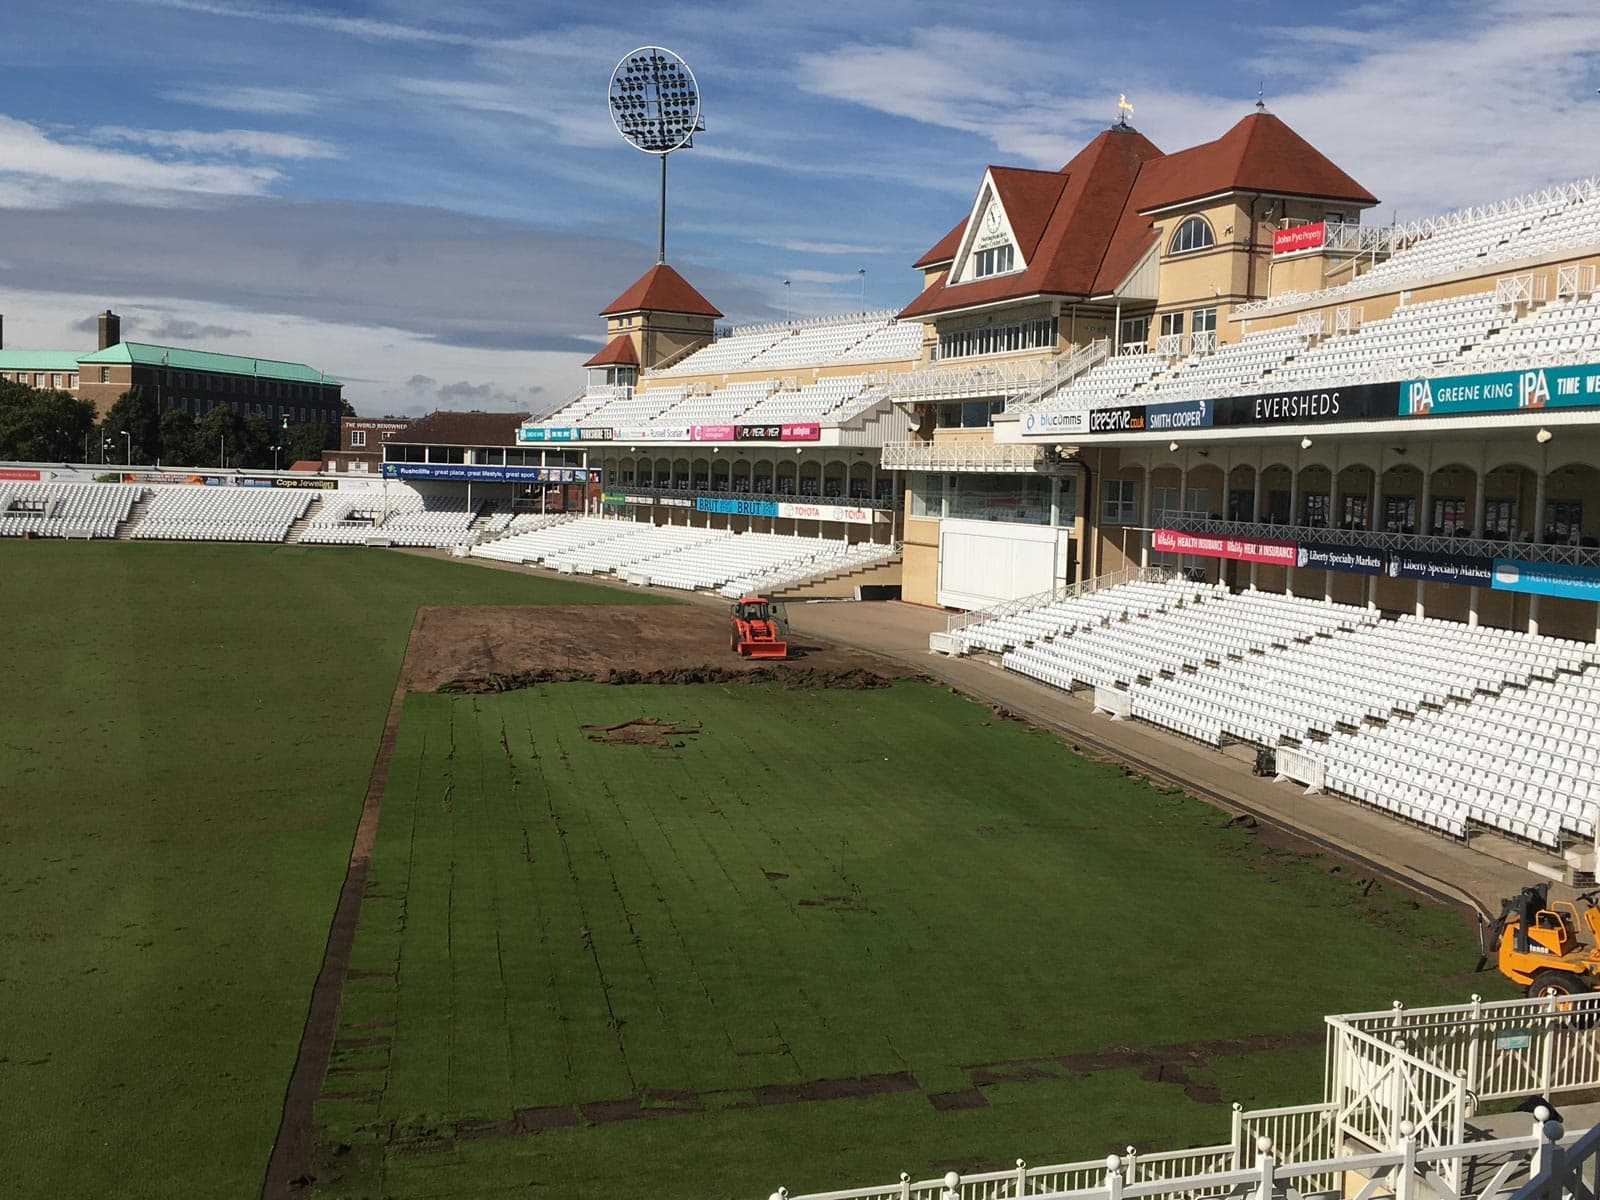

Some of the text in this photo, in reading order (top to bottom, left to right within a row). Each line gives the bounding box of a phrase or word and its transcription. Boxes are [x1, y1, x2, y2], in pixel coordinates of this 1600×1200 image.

[1276, 235, 1292, 245] John
[1409, 379, 1434, 414] IPA
[1437, 386, 1480, 402] GREENE
[1483, 383, 1513, 398] KING
[1519, 369, 1550, 407] IPA
[1557, 377, 1580, 395] TIME
[1255, 392, 1340, 419] EVERSHEDS
[1150, 411, 1201, 428] SMITH COOPER
[276, 479, 298, 487] Cope
[699, 498, 720, 512] BRUT
[737, 502, 761, 515] BRUT
[795, 506, 867, 520] TOYOTA TOYOTA
[1177, 536, 1199, 549] HEALTH
[1309, 550, 1381, 568] Liberty Specialty Markets
[1403, 559, 1426, 575] Liberty
[1459, 564, 1491, 578] Markets
